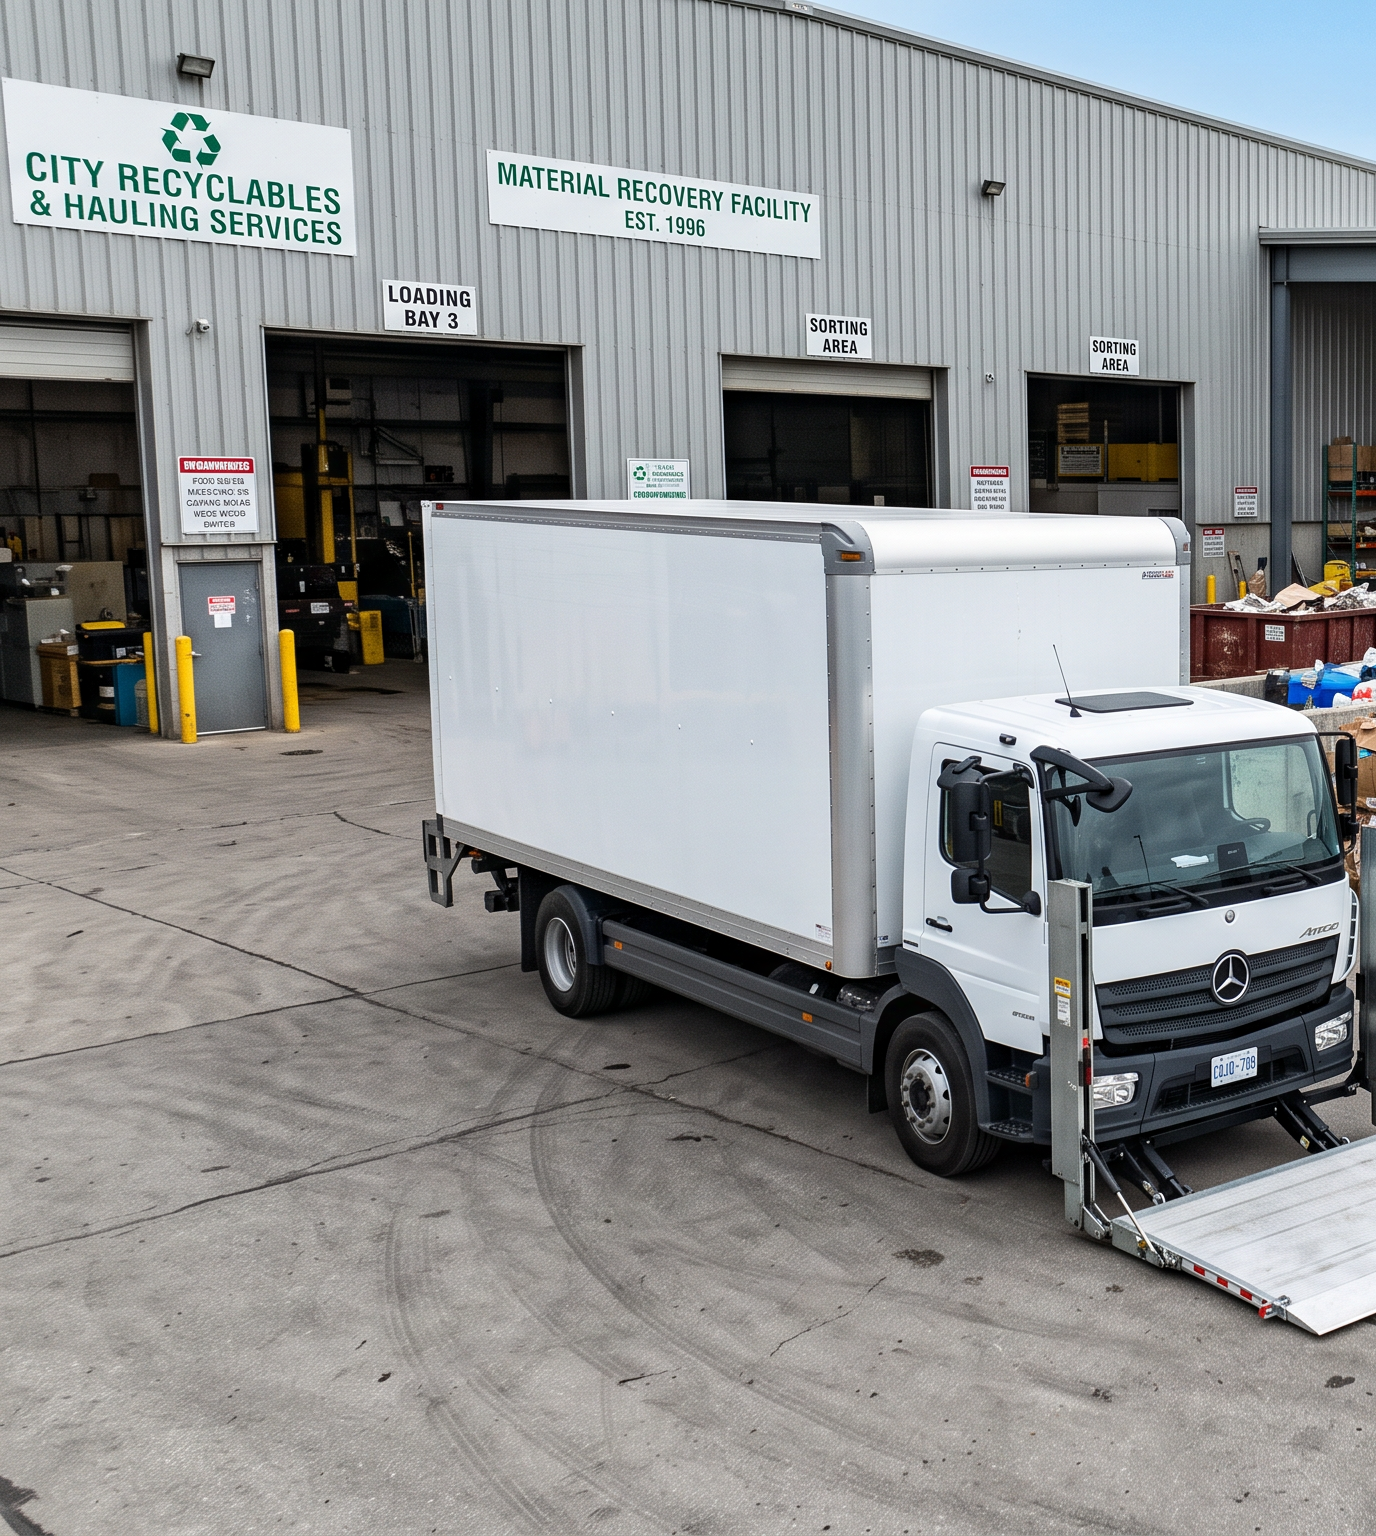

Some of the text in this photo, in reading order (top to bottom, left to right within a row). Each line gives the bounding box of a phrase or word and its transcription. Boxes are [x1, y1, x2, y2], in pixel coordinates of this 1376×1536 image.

[26, 151, 341, 215] CITY RECYCLABLES
[497, 161, 812, 223] MATERIAL RECOVERY FACILITY
[30, 189, 343, 246] & HAULING SERVICES
[624, 210, 706, 237] EST. 1996
[388, 284, 472, 308] LOADING
[404, 309, 459, 330] BAY 3
[810, 317, 868, 336] SORTING
[822, 338, 858, 354] AREA
[1092, 339, 1137, 356] SORTING
[1101, 357, 1129, 372] AREA
